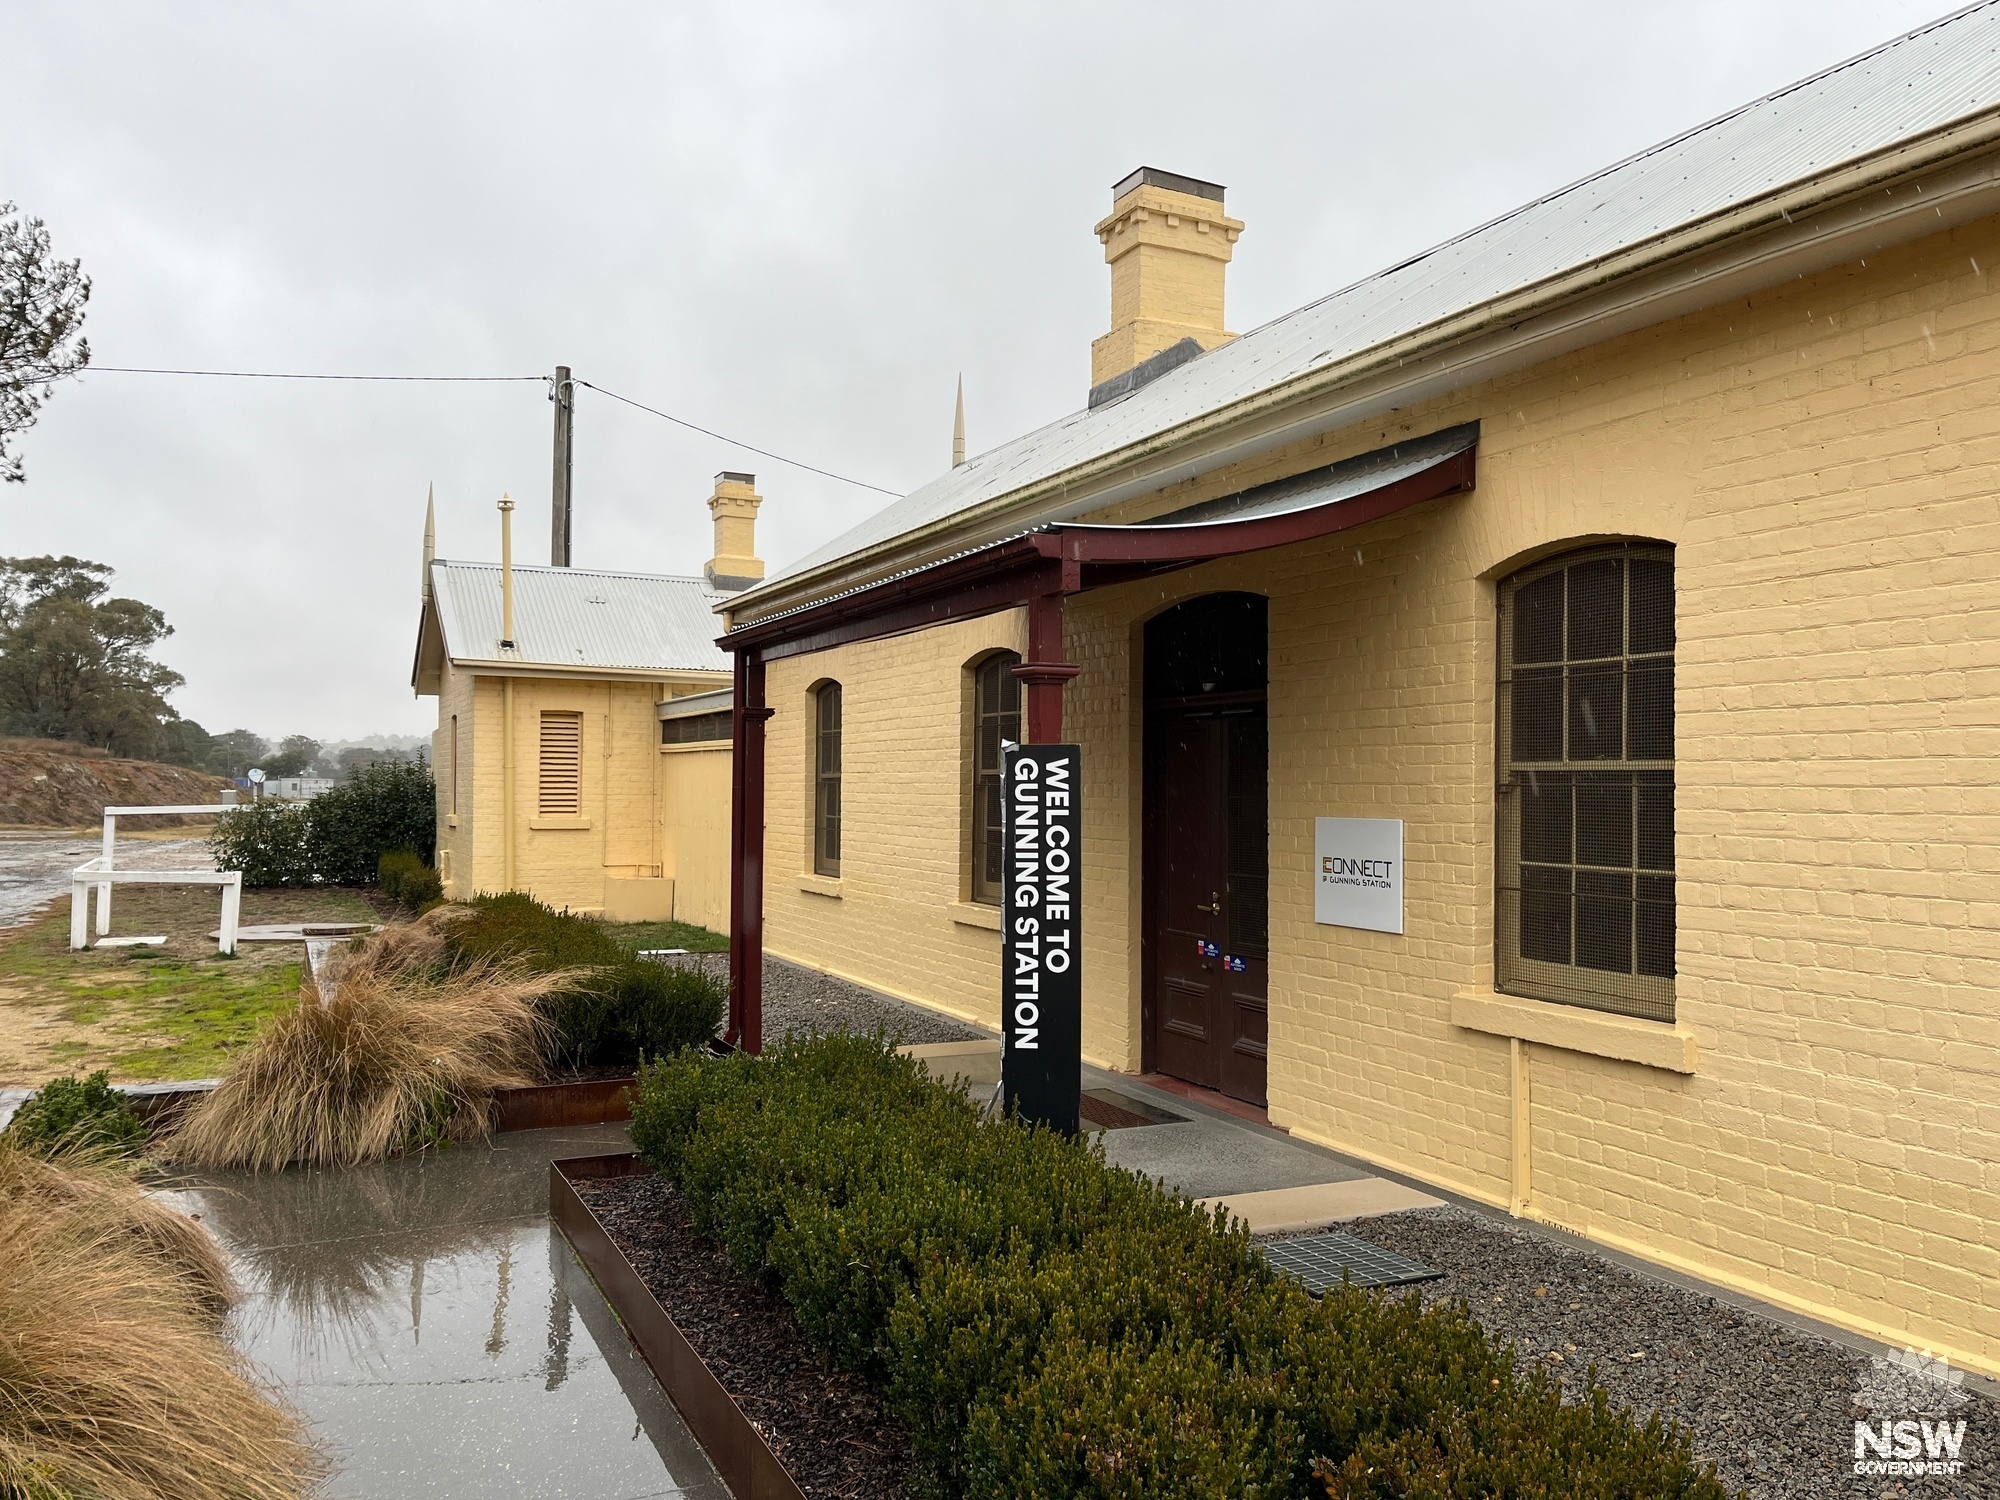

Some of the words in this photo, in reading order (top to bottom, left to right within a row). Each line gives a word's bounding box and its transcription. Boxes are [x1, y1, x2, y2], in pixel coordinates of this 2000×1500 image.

[1014, 757, 1039, 908] GUNNING
[1045, 757, 1070, 921] WELCOME
[1322, 856, 1392, 878] CONNECT
[1330, 876, 1360, 886] GUNNING
[1362, 879, 1392, 888] STATION
[1014, 917, 1039, 1050] STATION
[1045, 930, 1070, 974] TO
